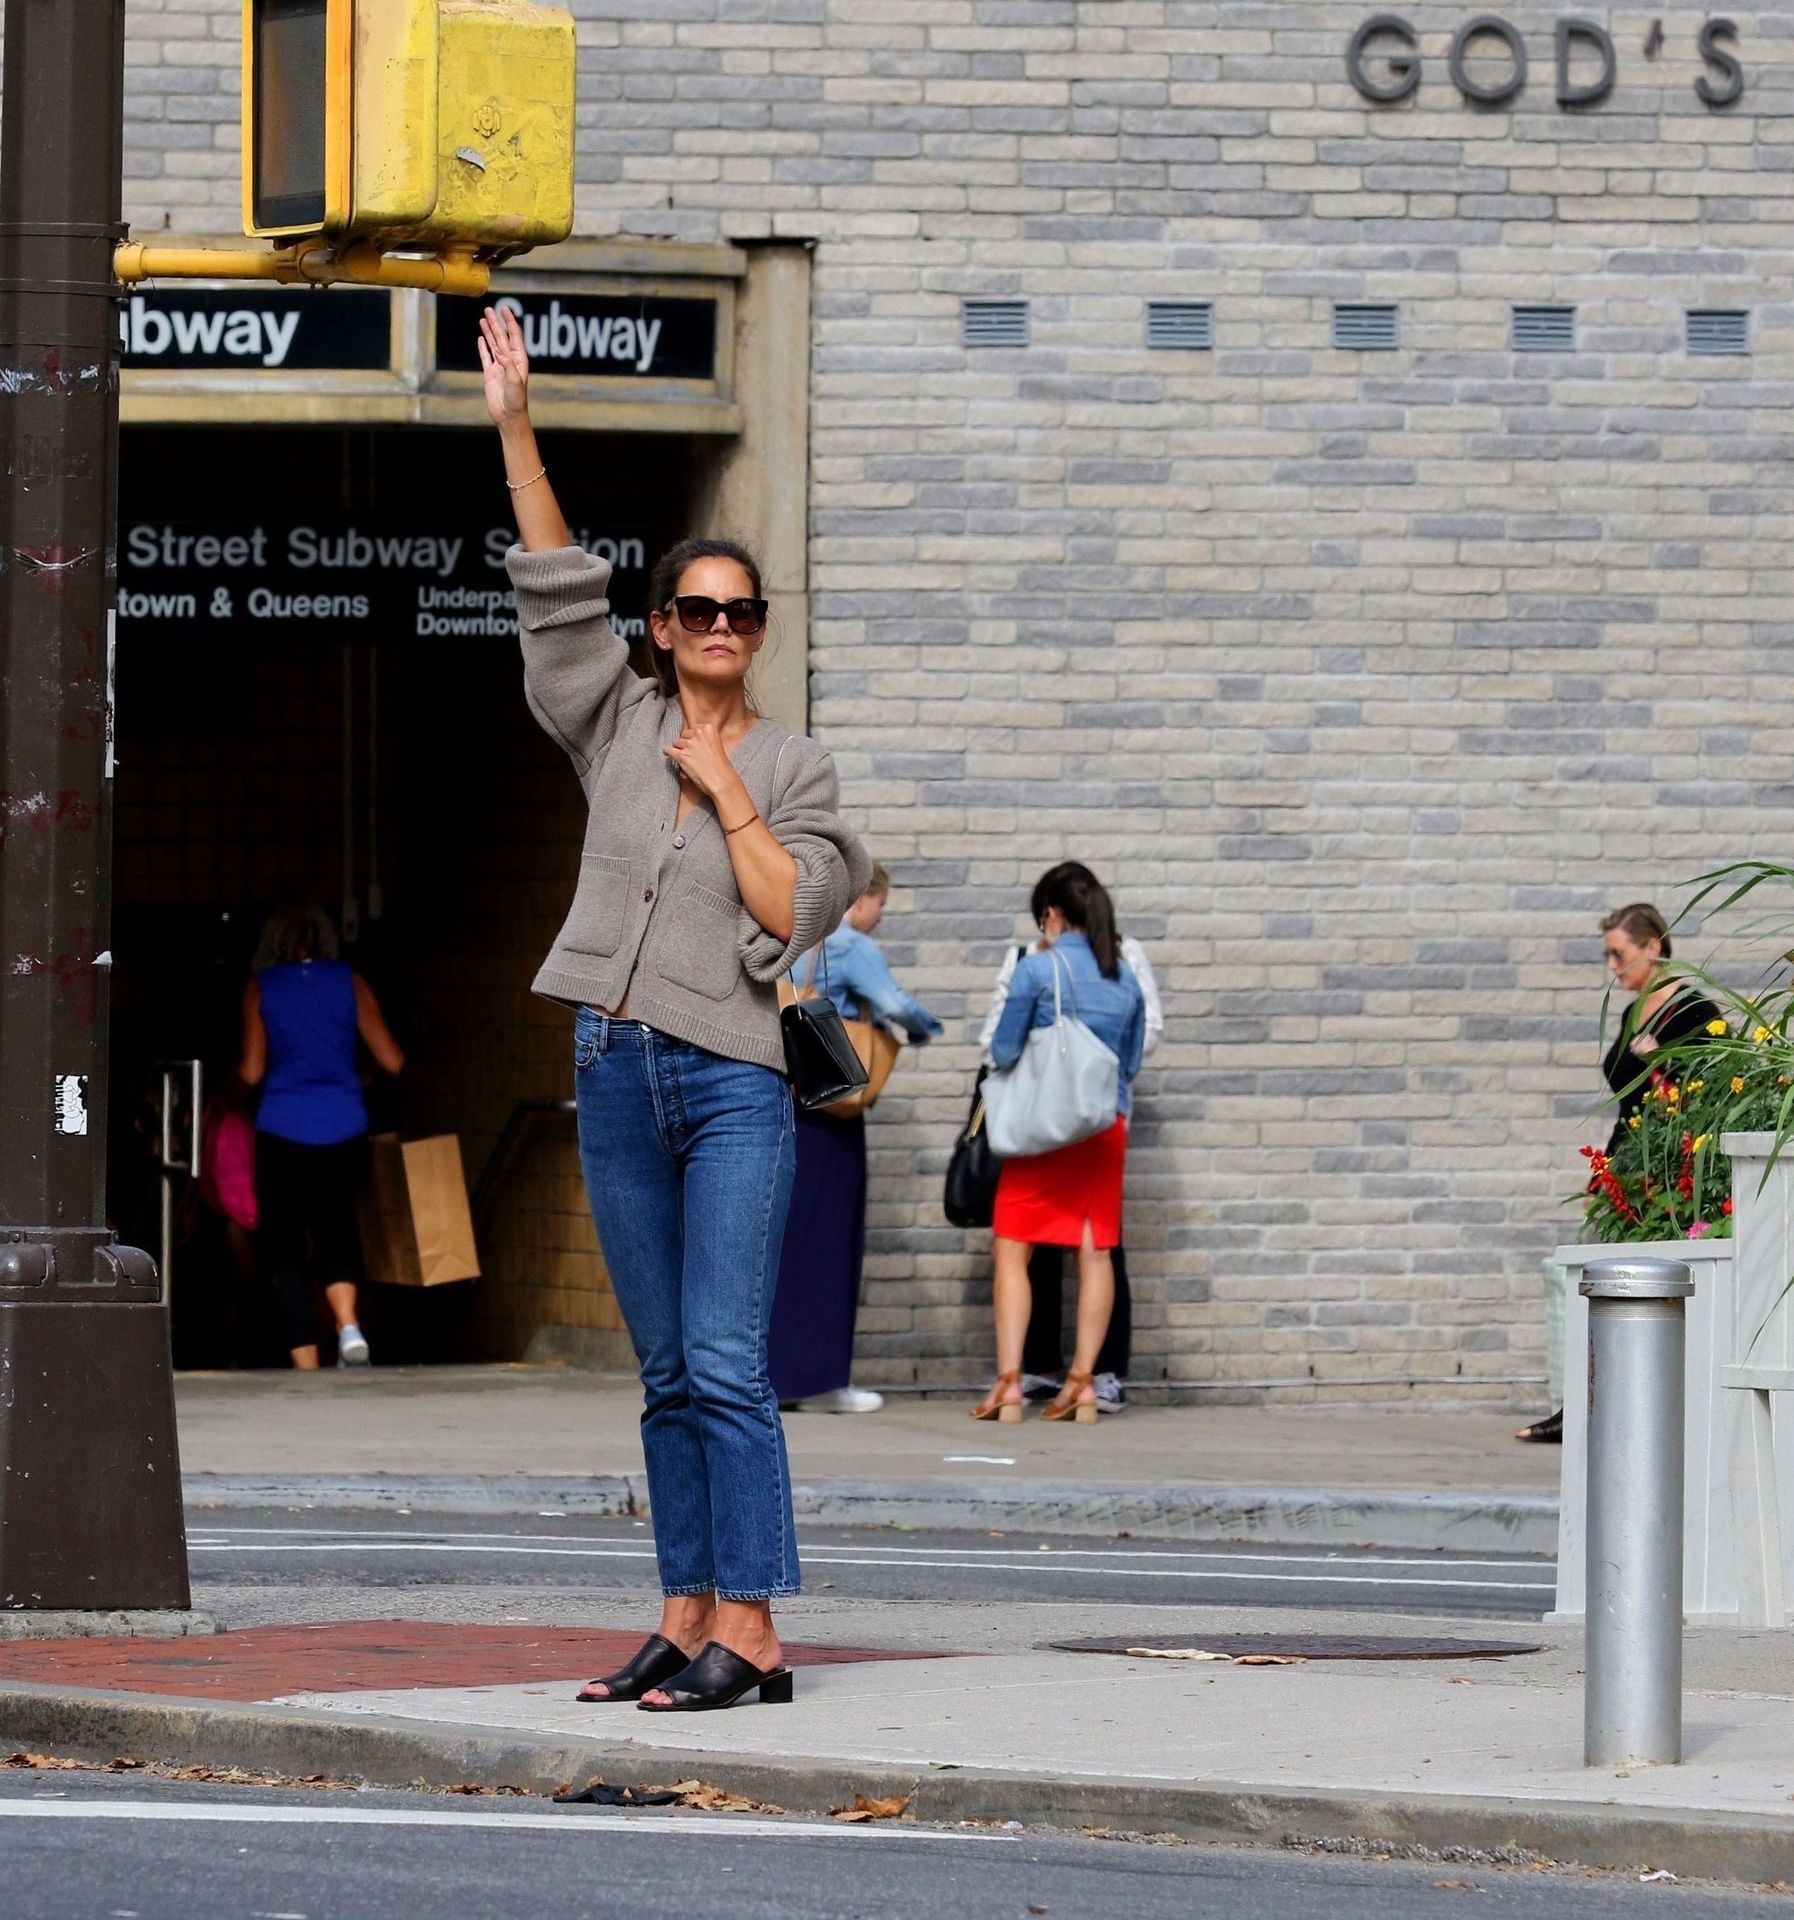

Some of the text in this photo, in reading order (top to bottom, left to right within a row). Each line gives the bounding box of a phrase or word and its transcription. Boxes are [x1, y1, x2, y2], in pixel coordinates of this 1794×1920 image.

[1346, 14, 1744, 109] GOD'S
[119, 296, 301, 367] bway
[127, 525, 645, 577] Street Subway Sion
[117, 586, 370, 619] town & Queens
[418, 585, 517, 612] Underpa
[416, 612, 520, 636] Downto
